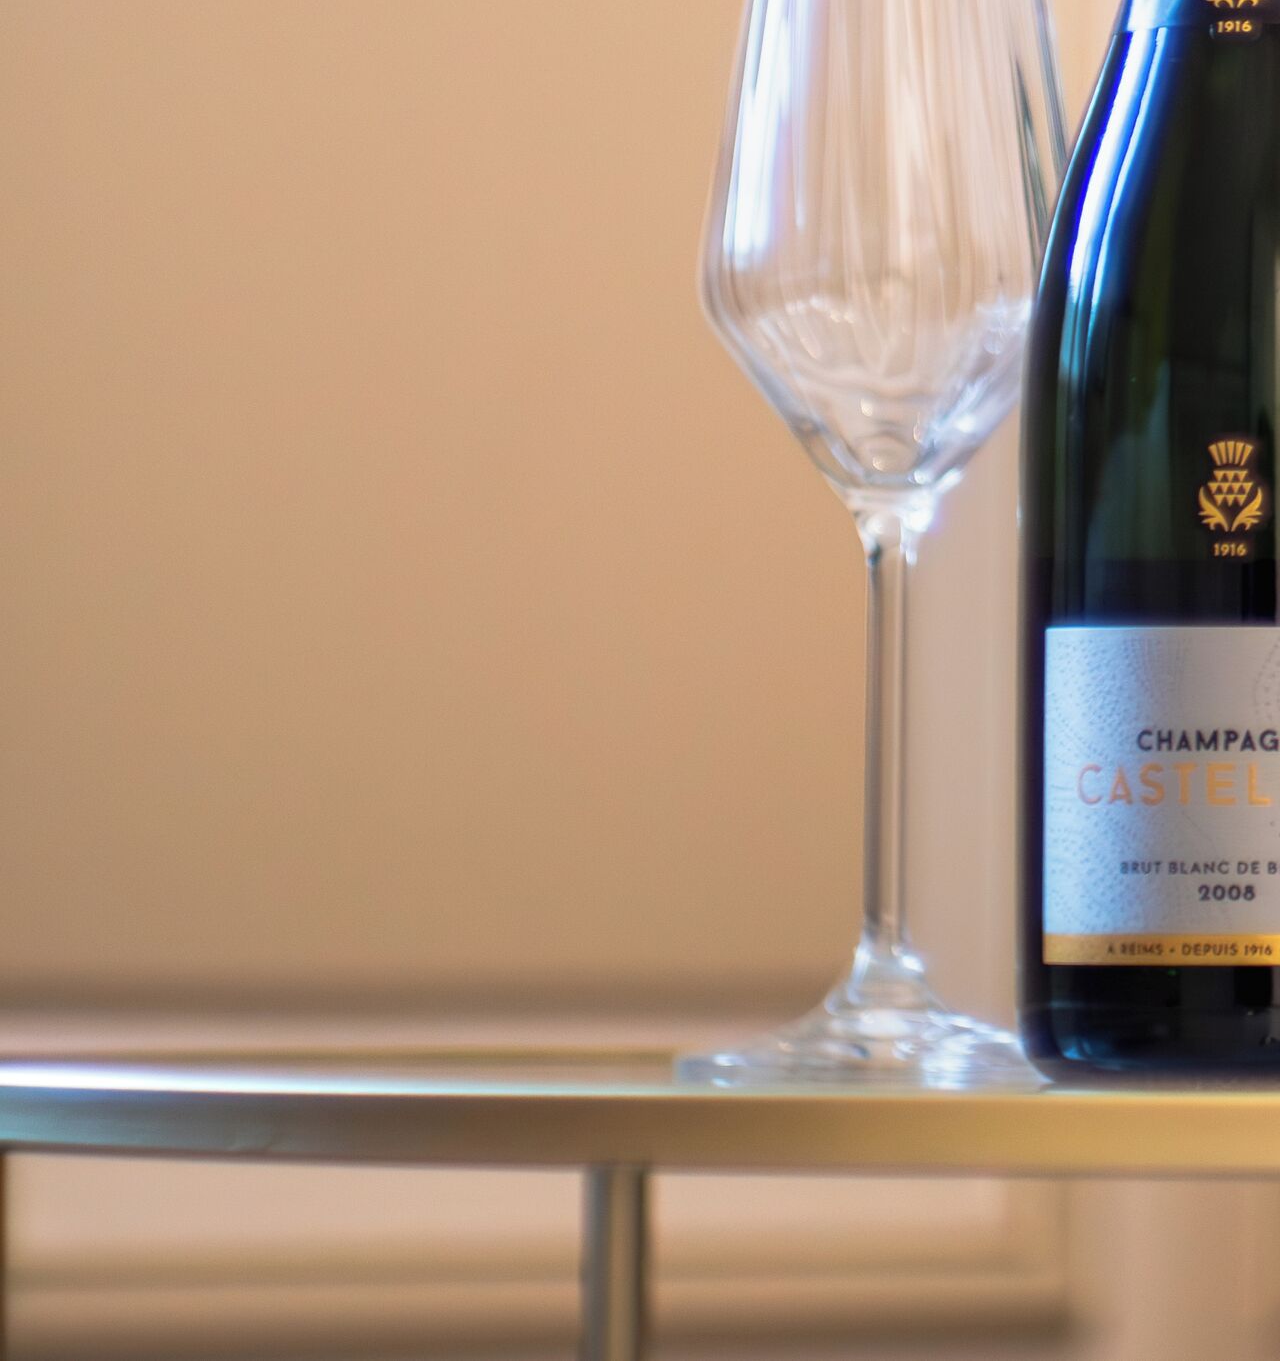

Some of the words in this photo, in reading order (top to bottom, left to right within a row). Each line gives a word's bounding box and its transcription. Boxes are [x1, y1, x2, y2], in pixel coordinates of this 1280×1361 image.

[1216, 19, 1253, 33] 1916
[1213, 542, 1248, 557] 1916
[1119, 861, 1161, 875] BRUT
[1168, 860, 1230, 876] BLANC
[1236, 860, 1261, 876] DE
[1198, 883, 1257, 902] 2008
[1120, 942, 1163, 956] REIMS
[1181, 943, 1238, 956] DEPUIS
[1244, 943, 1273, 956] 1916
